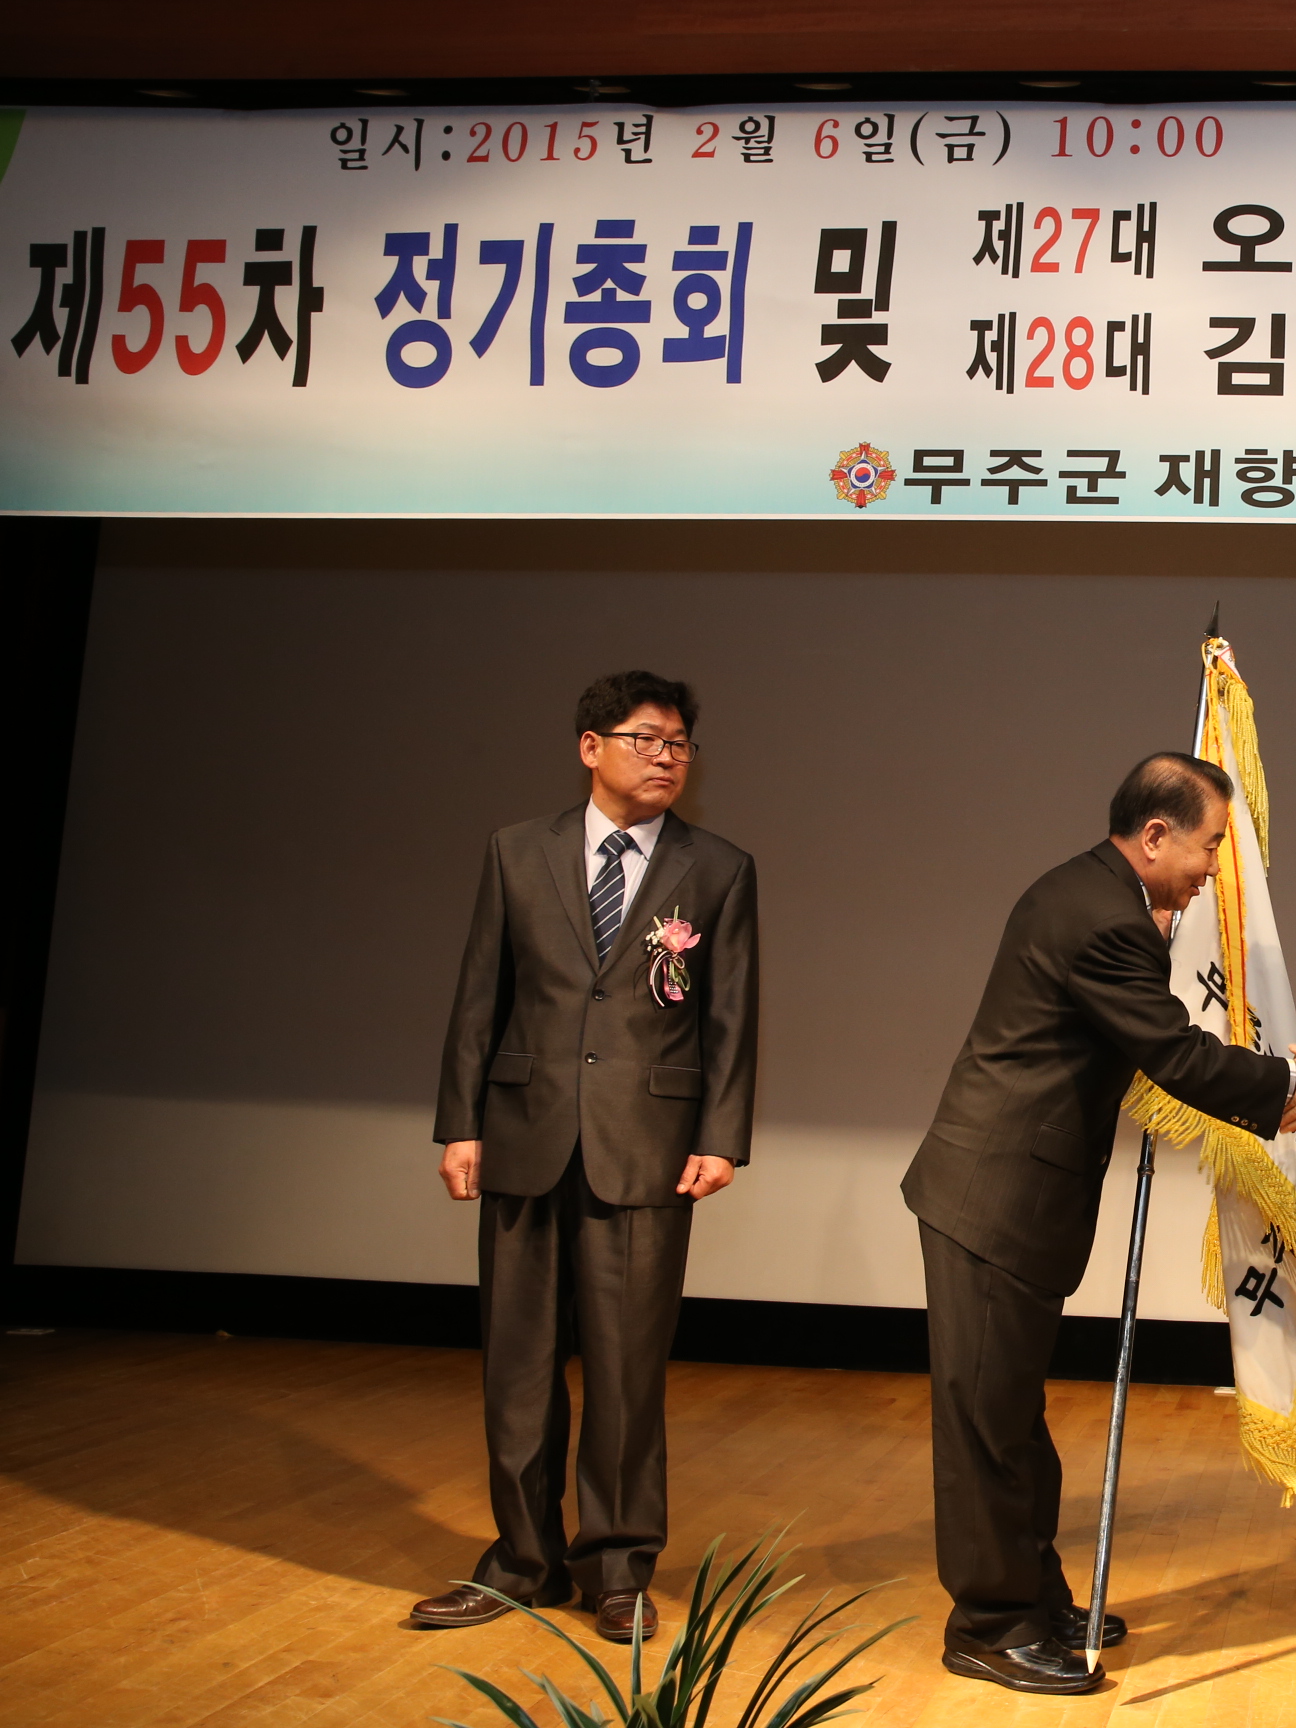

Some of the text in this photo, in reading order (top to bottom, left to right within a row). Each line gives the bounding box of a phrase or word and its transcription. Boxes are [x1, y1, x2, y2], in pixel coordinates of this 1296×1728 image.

[329, 110, 1224, 172] 일시:2015년 2월 6일(금) 10:00
[972, 201, 1157, 279] 제27대
[10, 218, 898, 390] 제55차 정기총회 및
[966, 312, 1152, 396] 제28대
[903, 448, 1127, 506] 무주군
